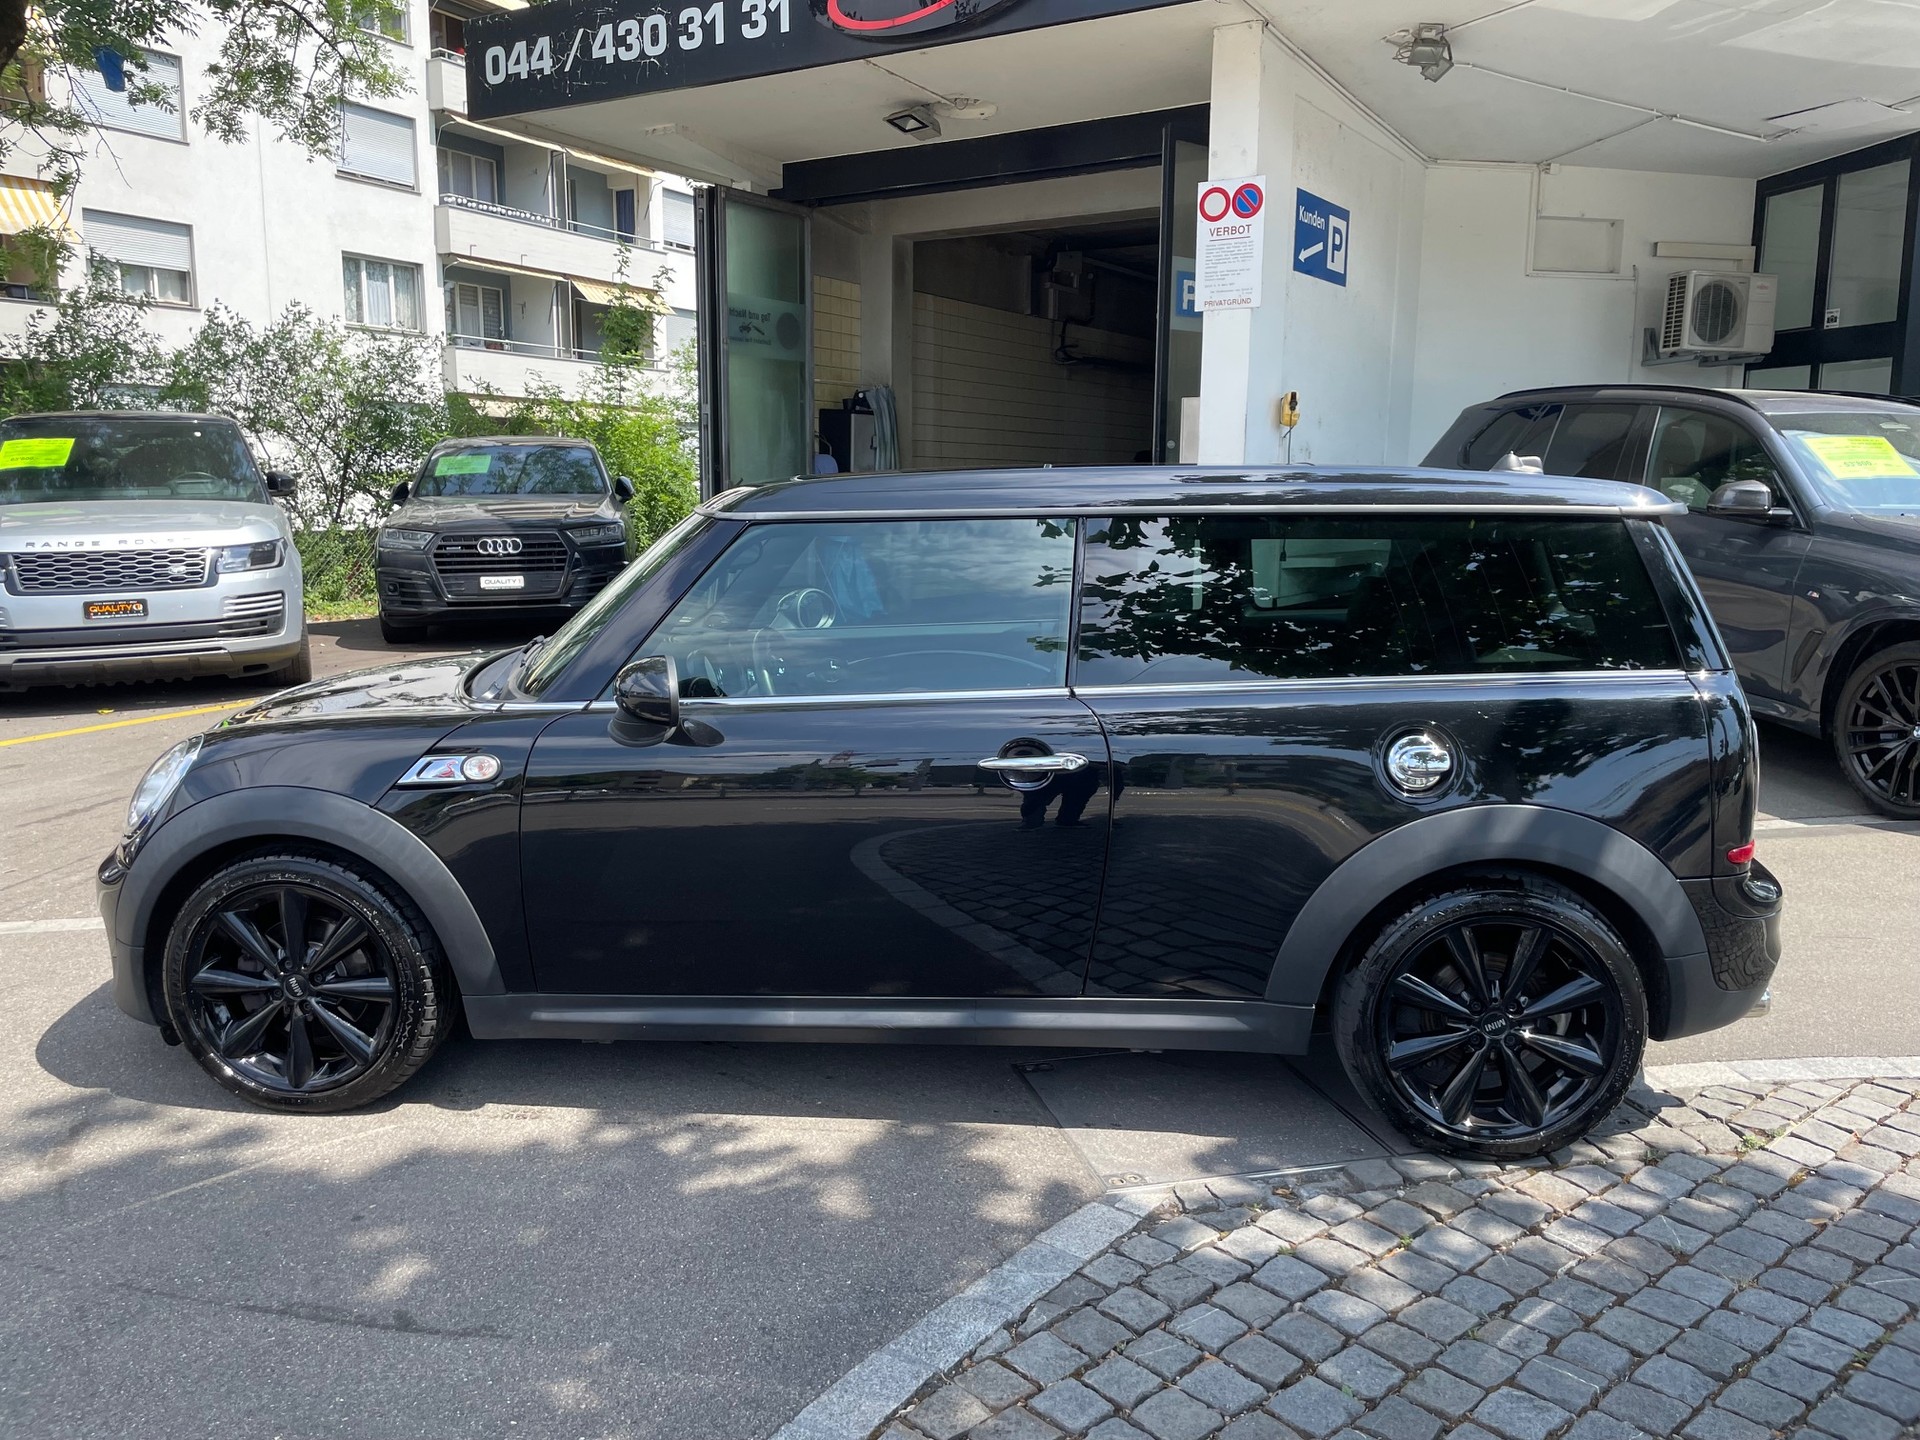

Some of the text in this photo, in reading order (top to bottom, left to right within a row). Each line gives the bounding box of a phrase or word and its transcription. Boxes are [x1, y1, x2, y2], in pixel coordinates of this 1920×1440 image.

[485, 0, 790, 85] 044 / 430 31 31
[1299, 205, 1326, 230] Kunden
[1209, 224, 1252, 237] VERBOT
[1331, 226, 1343, 263] P
[1204, 297, 1252, 307] PRIVATGRUND
[118, 537, 192, 545] ROV
[89, 604, 132, 613] QUALITY
[289, 977, 304, 996] MINI
[1484, 1018, 1507, 1032] MINI
